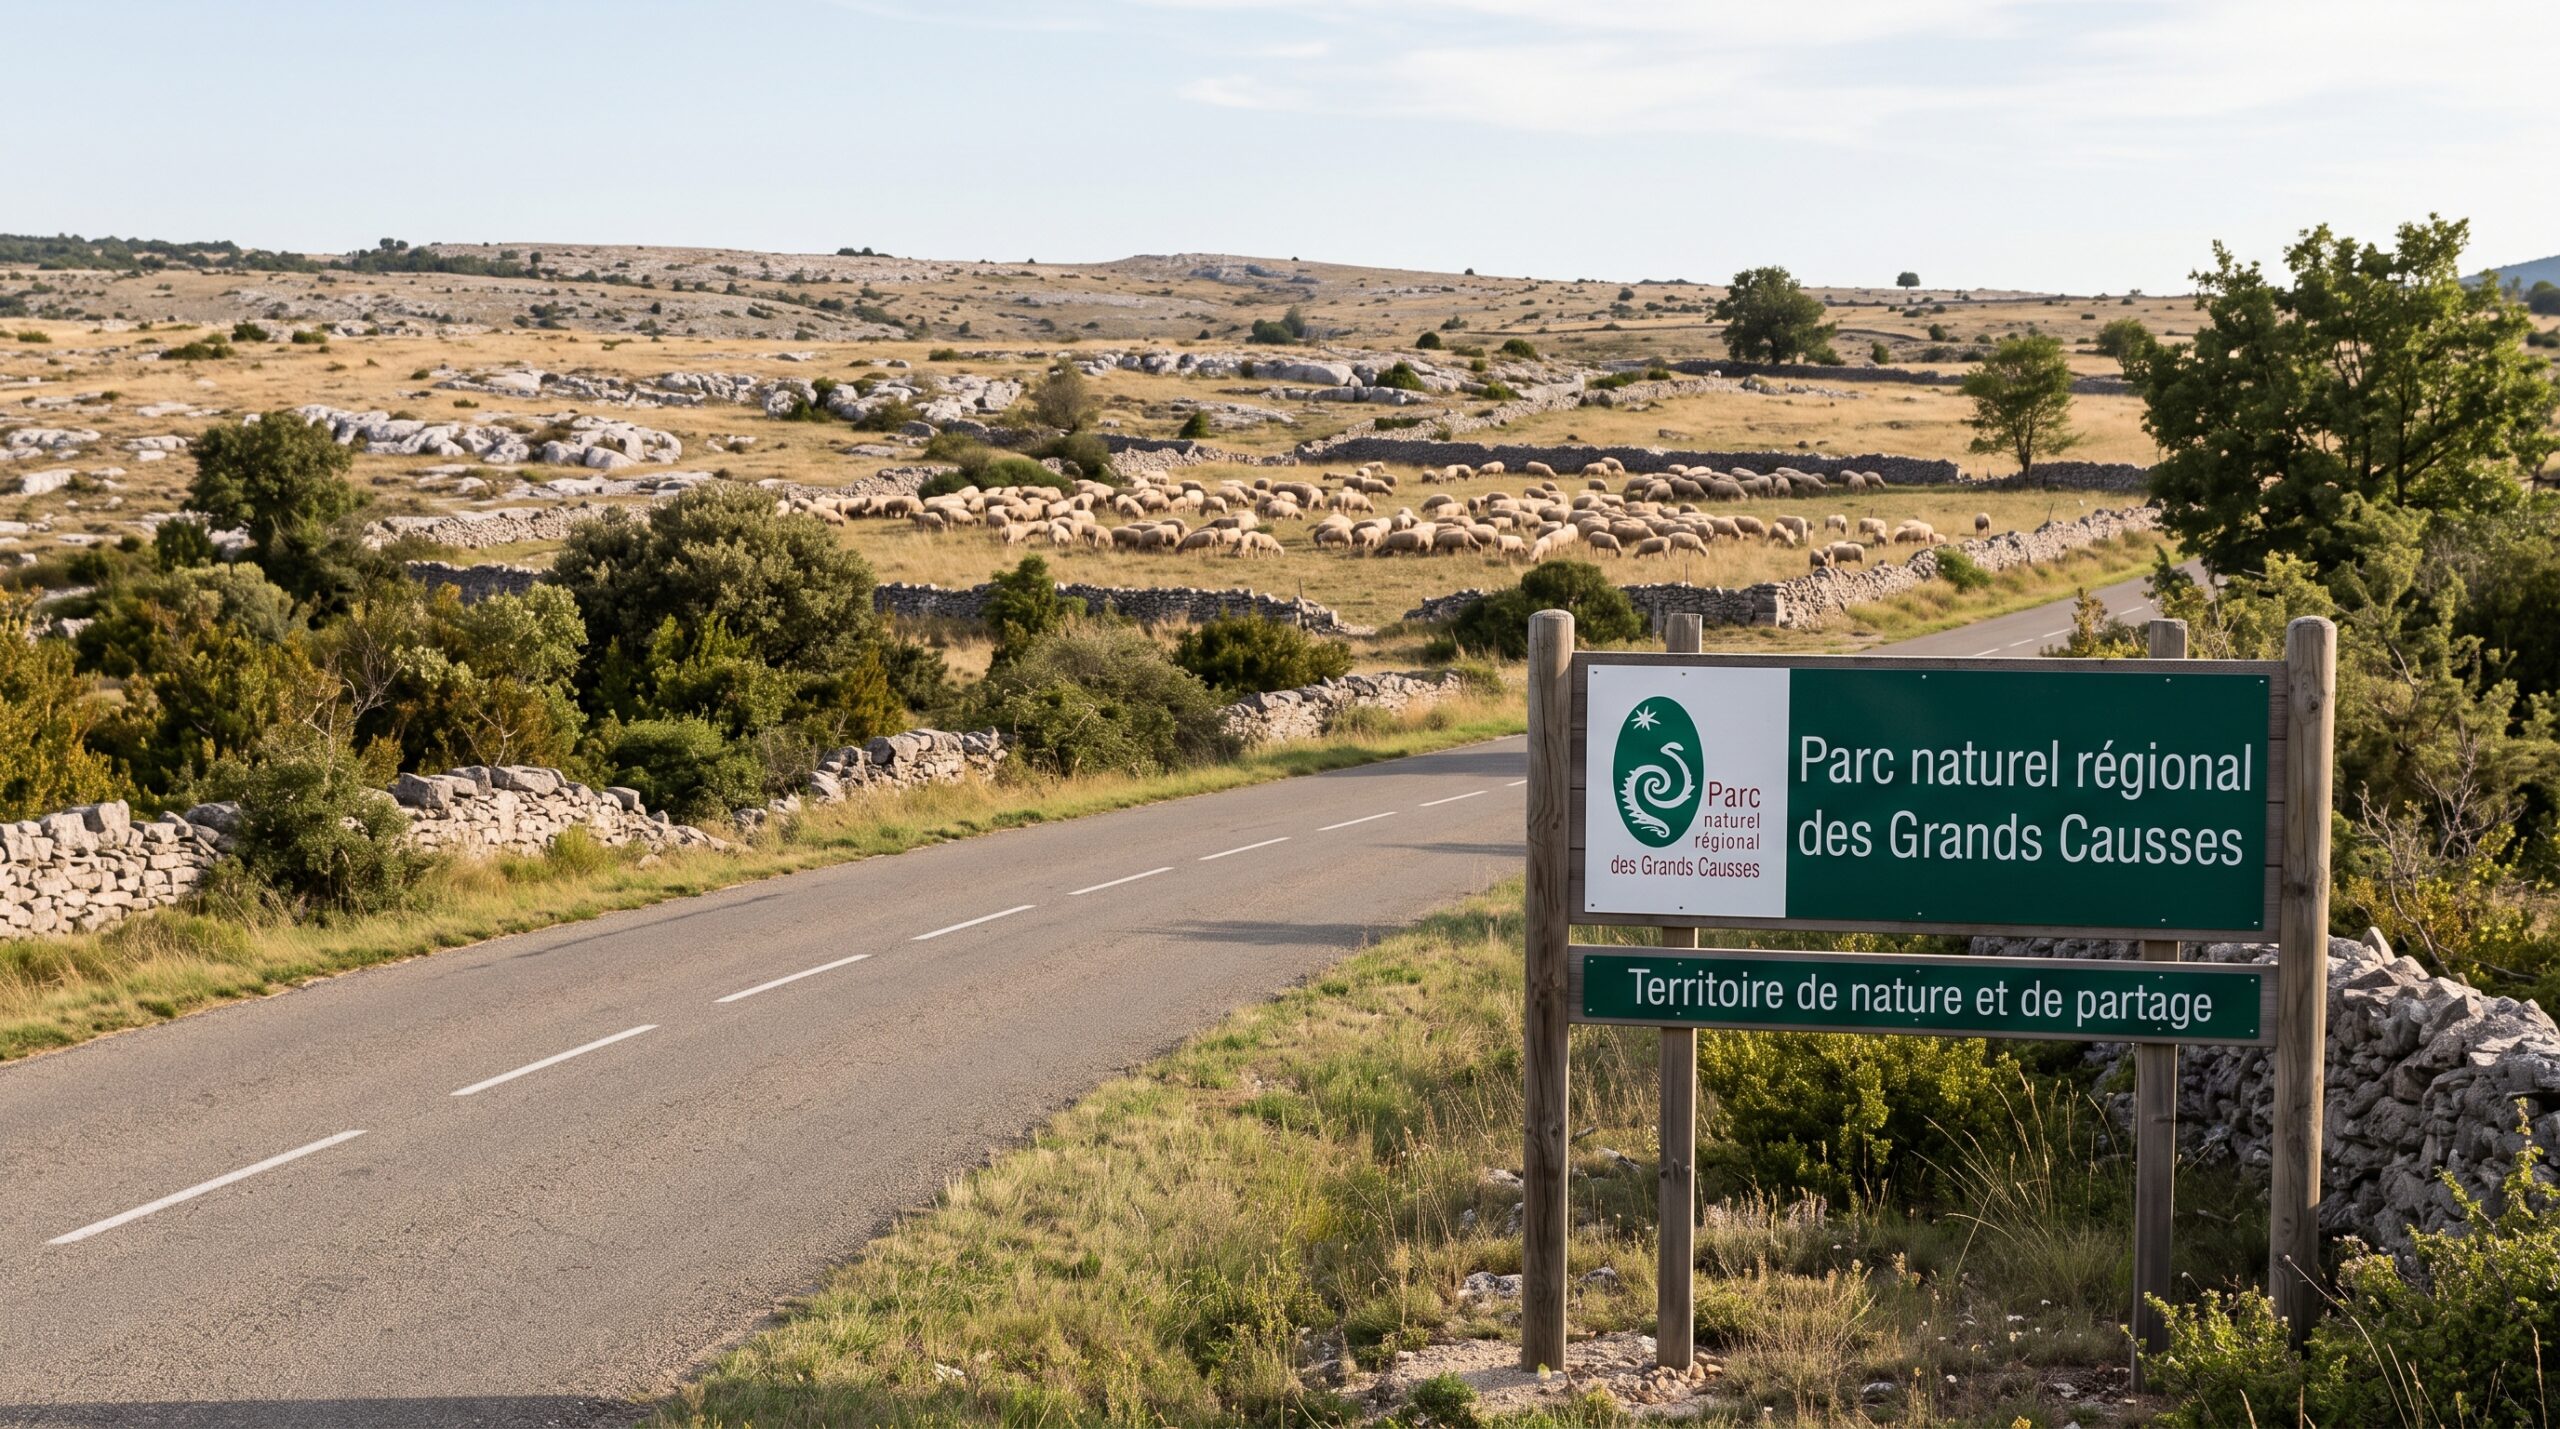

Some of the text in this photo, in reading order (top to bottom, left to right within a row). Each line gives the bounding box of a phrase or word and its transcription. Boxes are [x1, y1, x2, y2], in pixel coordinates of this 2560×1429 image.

[1802, 736, 2251, 800] Parc naturel régional
[1709, 781, 1760, 808] Parc
[1705, 812, 1759, 828] naturel
[1695, 832, 1759, 853] régional
[1799, 810, 2242, 865] des Grands Causses
[1611, 855, 1759, 878] des Grands Causses
[1628, 969, 2211, 1029] Territoire de nature et de partage
